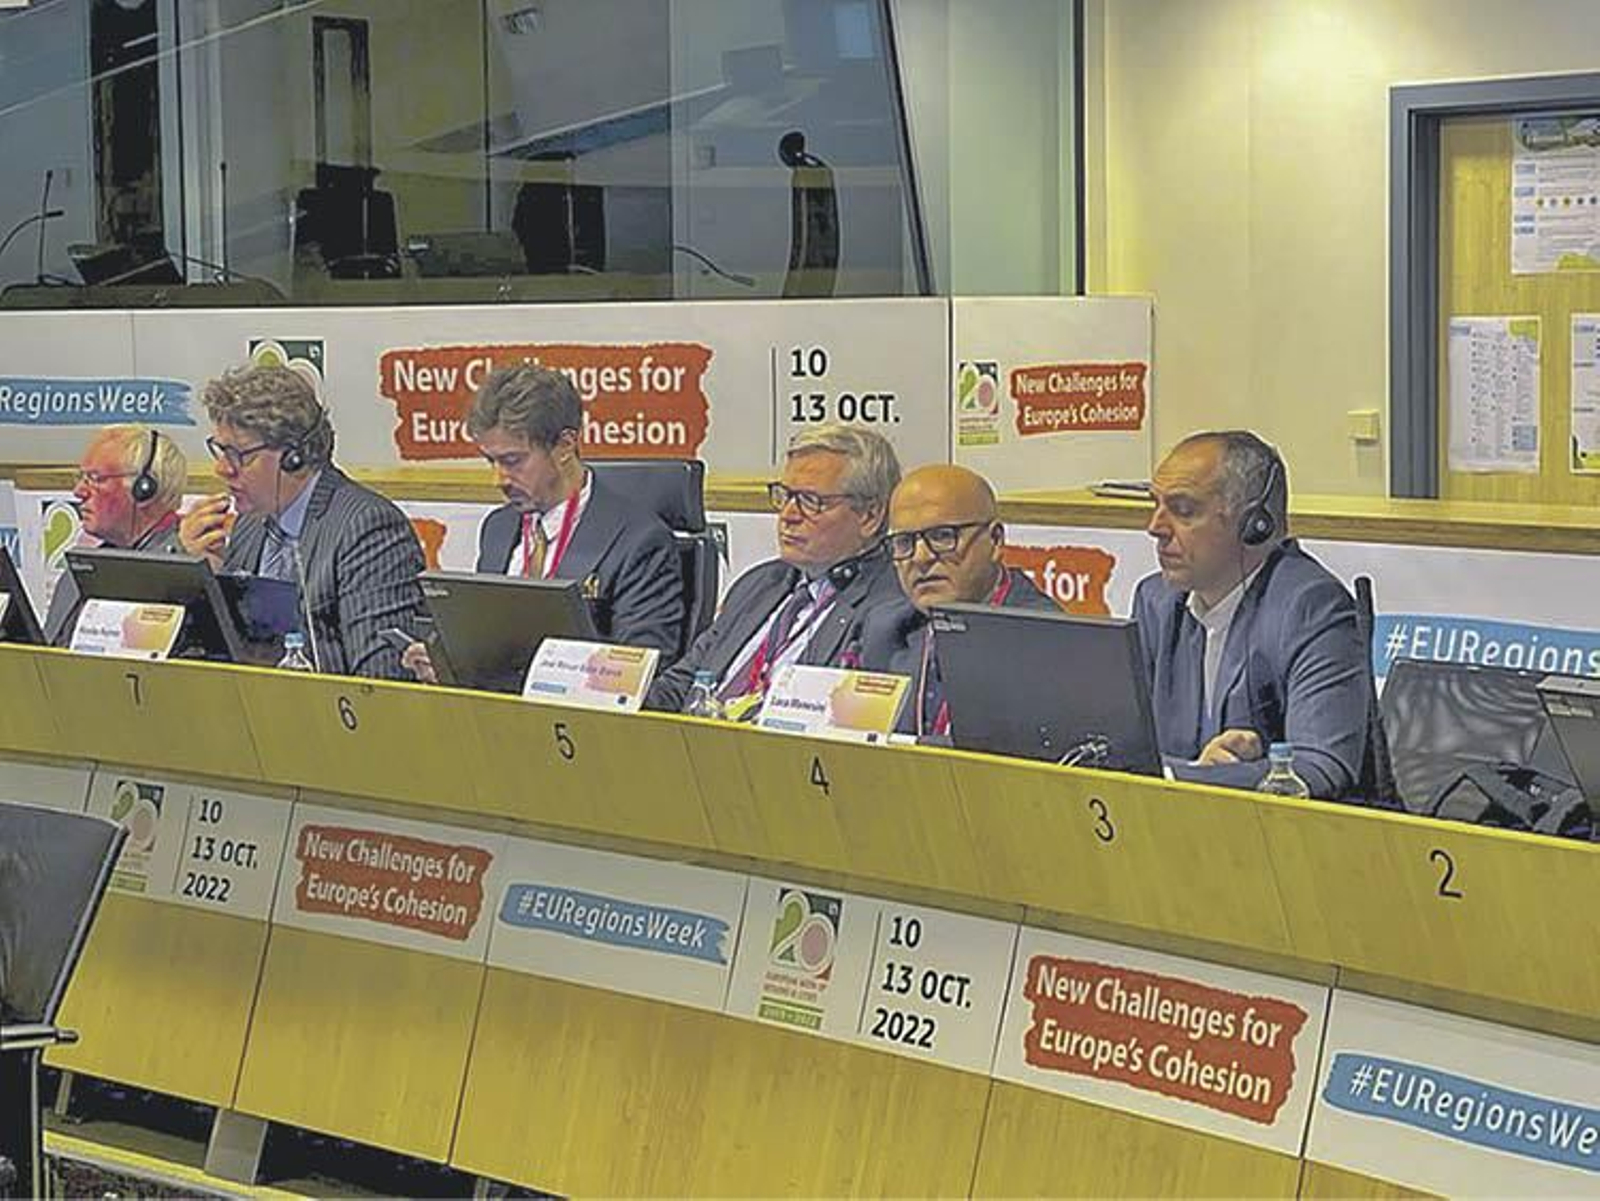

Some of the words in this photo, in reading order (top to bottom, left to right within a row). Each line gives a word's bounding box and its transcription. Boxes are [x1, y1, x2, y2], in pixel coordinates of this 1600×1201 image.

[393, 358, 459, 393] New
[639, 355, 686, 393] for
[790, 348, 828, 378] 10
[1015, 373, 1046, 394] New
[1048, 371, 1118, 398] Challenges
[1119, 370, 1138, 391] for
[791, 393, 827, 422] 13
[837, 393, 900, 423] OCT.
[1023, 403, 1078, 429] Europe's
[1079, 402, 1139, 424] Cohesion
[1042, 559, 1090, 602] for
[125, 673, 143, 706] 7
[337, 695, 358, 731] 6
[554, 723, 576, 760] 5
[809, 756, 830, 796] 4
[198, 799, 223, 824] 10
[1088, 797, 1115, 842] 3
[191, 836, 217, 861] 13
[220, 839, 258, 869] OCT.
[303, 831, 345, 862] New
[346, 838, 446, 882] Challenges
[446, 852, 477, 884] for
[182, 872, 232, 903] 2022
[1430, 849, 1463, 899] 2
[305, 873, 381, 912] Europe's
[383, 886, 469, 926] Cohesion
[516, 889, 708, 949] #EURegionsWeek
[889, 916, 922, 948] 10
[881, 962, 914, 995] 13
[920, 969, 972, 1009] OCT.
[1036, 963, 1092, 1006] New
[1095, 977, 1236, 1040] Challenges
[1241, 1007, 1283, 1048] for
[871, 1008, 936, 1049] 2022
[1039, 1018, 1144, 1071] Europe's
[1148, 1043, 1273, 1105] Cohesion
